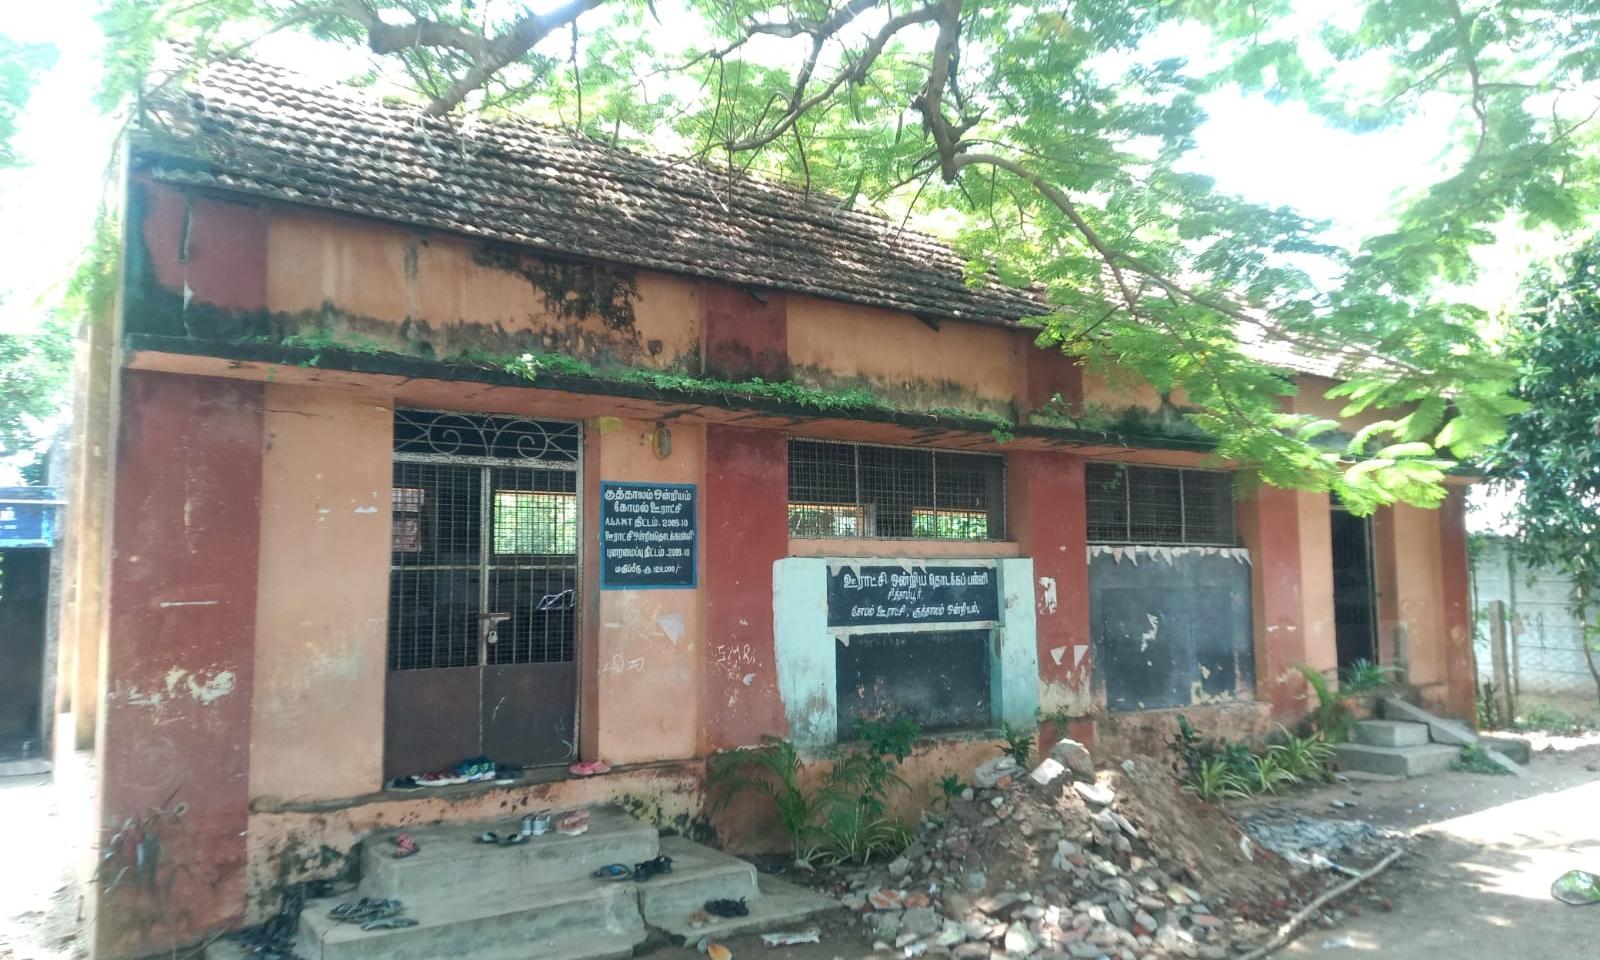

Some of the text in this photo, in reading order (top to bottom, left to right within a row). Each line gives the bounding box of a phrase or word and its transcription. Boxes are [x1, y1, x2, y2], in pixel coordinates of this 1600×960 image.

[654, 488, 692, 502] ஒன்றியம்
[614, 501, 683, 514] கோமல் ஊராட்சி
[843, 571, 989, 590] ஊராட்சி ஒன்றிய தொடக்கப் பள்ளி
